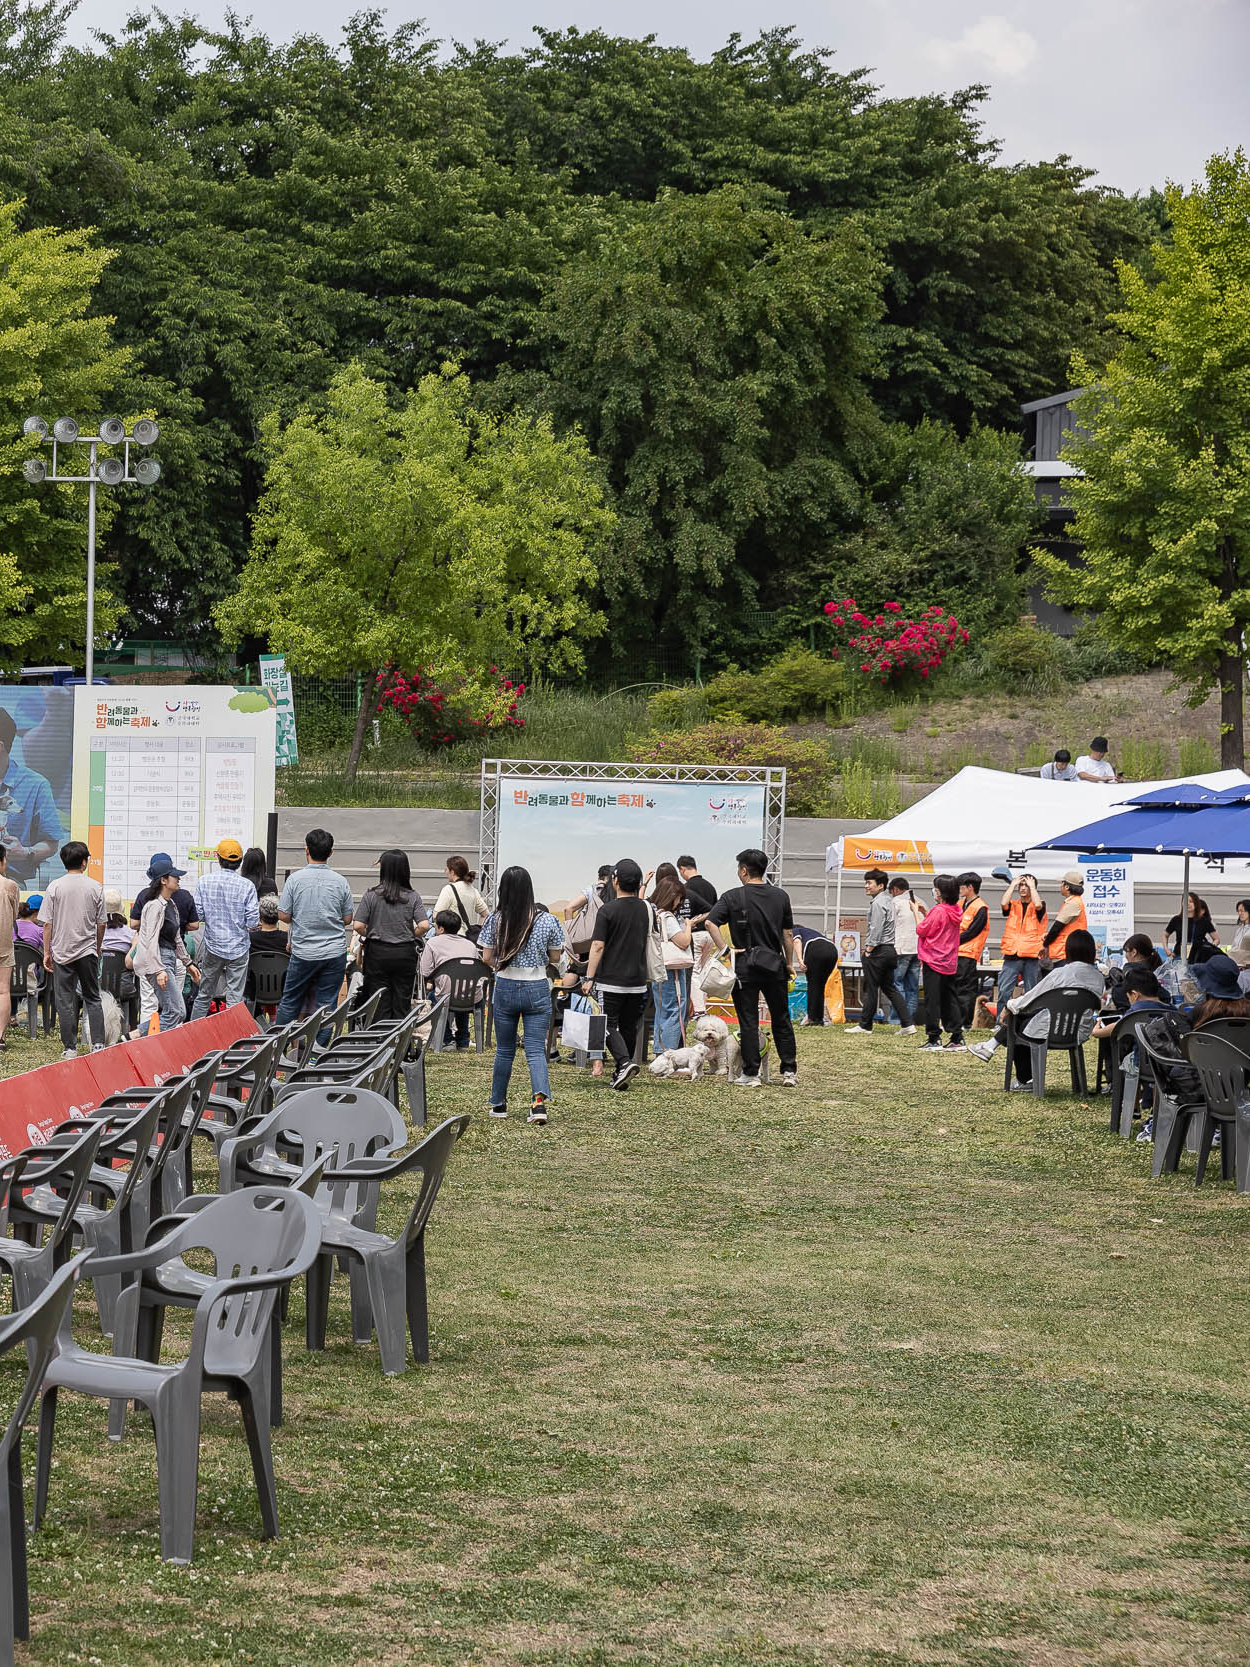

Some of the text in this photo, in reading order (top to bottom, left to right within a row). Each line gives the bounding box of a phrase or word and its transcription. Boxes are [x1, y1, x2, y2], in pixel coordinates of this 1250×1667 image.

[264, 667, 287, 680] 화장실
[96, 704, 138, 717] 반려동물과
[514, 790, 569, 808] 반려동물과
[1086, 868, 1126, 882] 운동회
[1093, 885, 1120, 898] 접수
